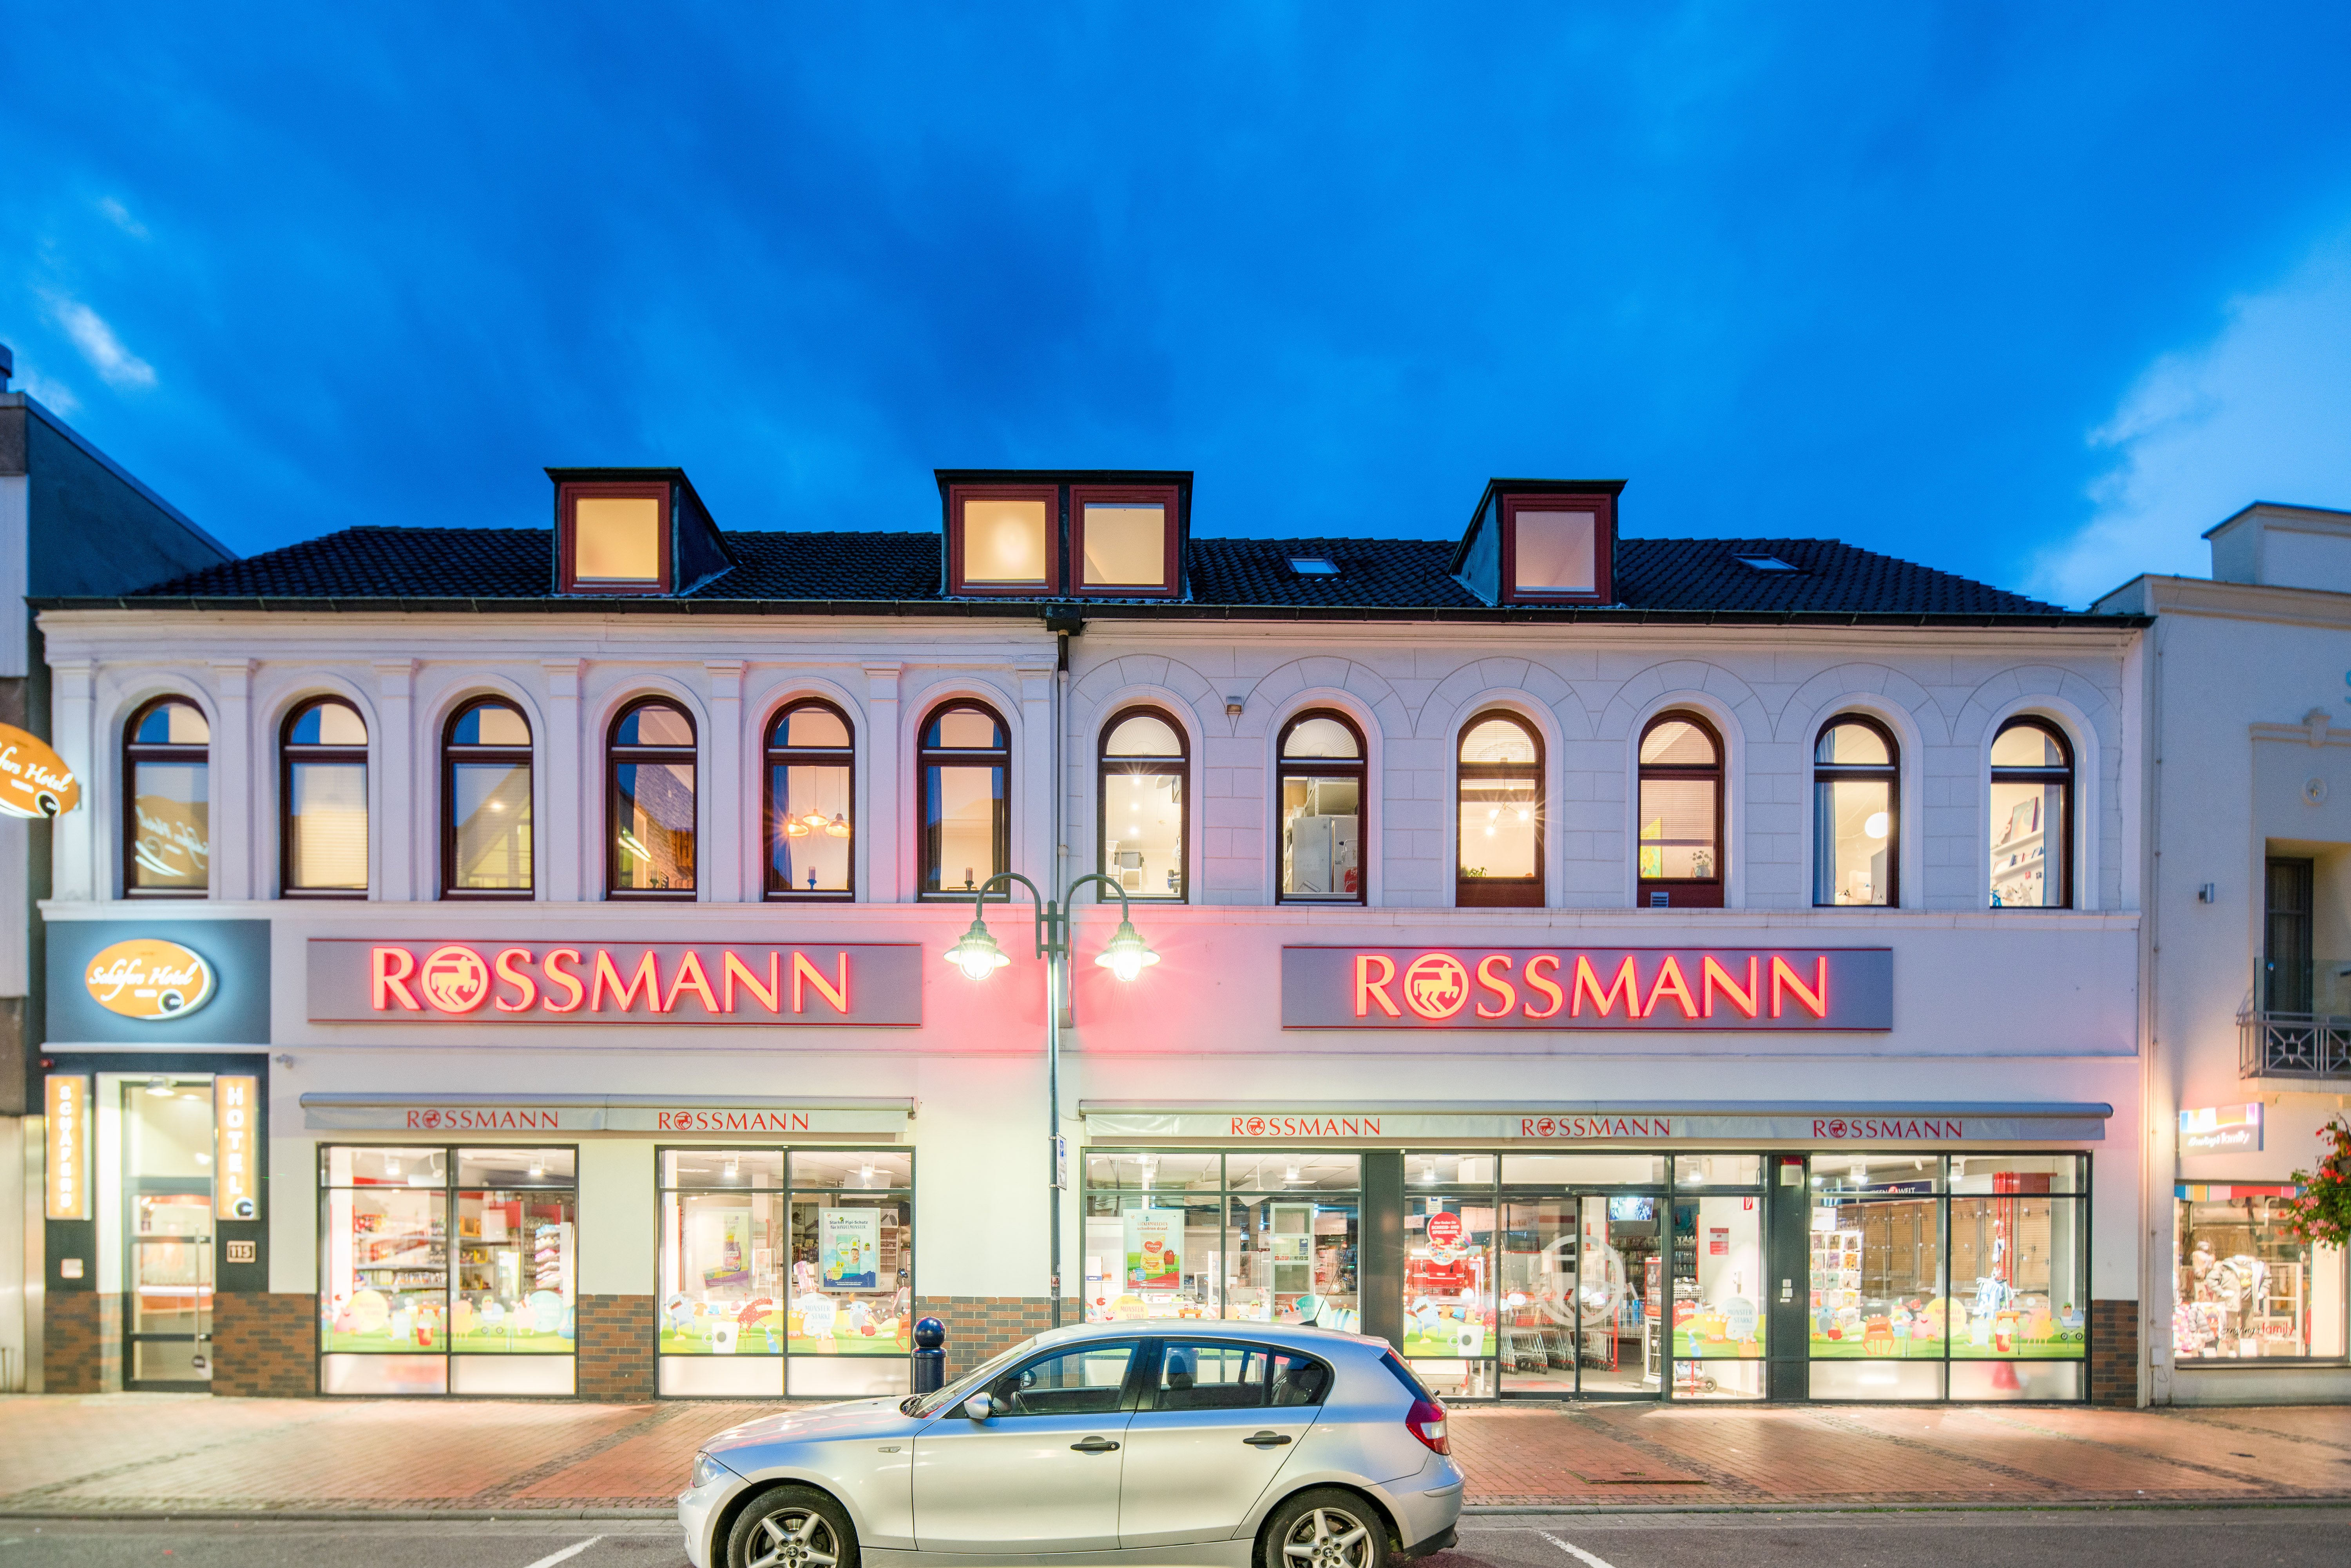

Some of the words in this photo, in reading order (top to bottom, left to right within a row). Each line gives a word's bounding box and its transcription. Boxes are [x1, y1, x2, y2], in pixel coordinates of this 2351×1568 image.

[24, 763, 74, 792] Hotel
[148, 962, 199, 985] Hotel
[372, 945, 848, 1014] ROSSMANN
[1355, 952, 1827, 1019] ROSSMANN
[407, 1109, 558, 1129] ROSSMANN
[658, 1111, 809, 1131] ROSSMANN
[1232, 1117, 1380, 1136] ROSSMANN
[1521, 1117, 1670, 1137] ROSSMANN
[1813, 1119, 1962, 1138] ROSSMANN
[226, 1086, 244, 1195] HOTEL
[1060, 1141, 1063, 1157] P
[230, 1246, 251, 1258] 115
[2262, 1322, 2295, 1336] family
